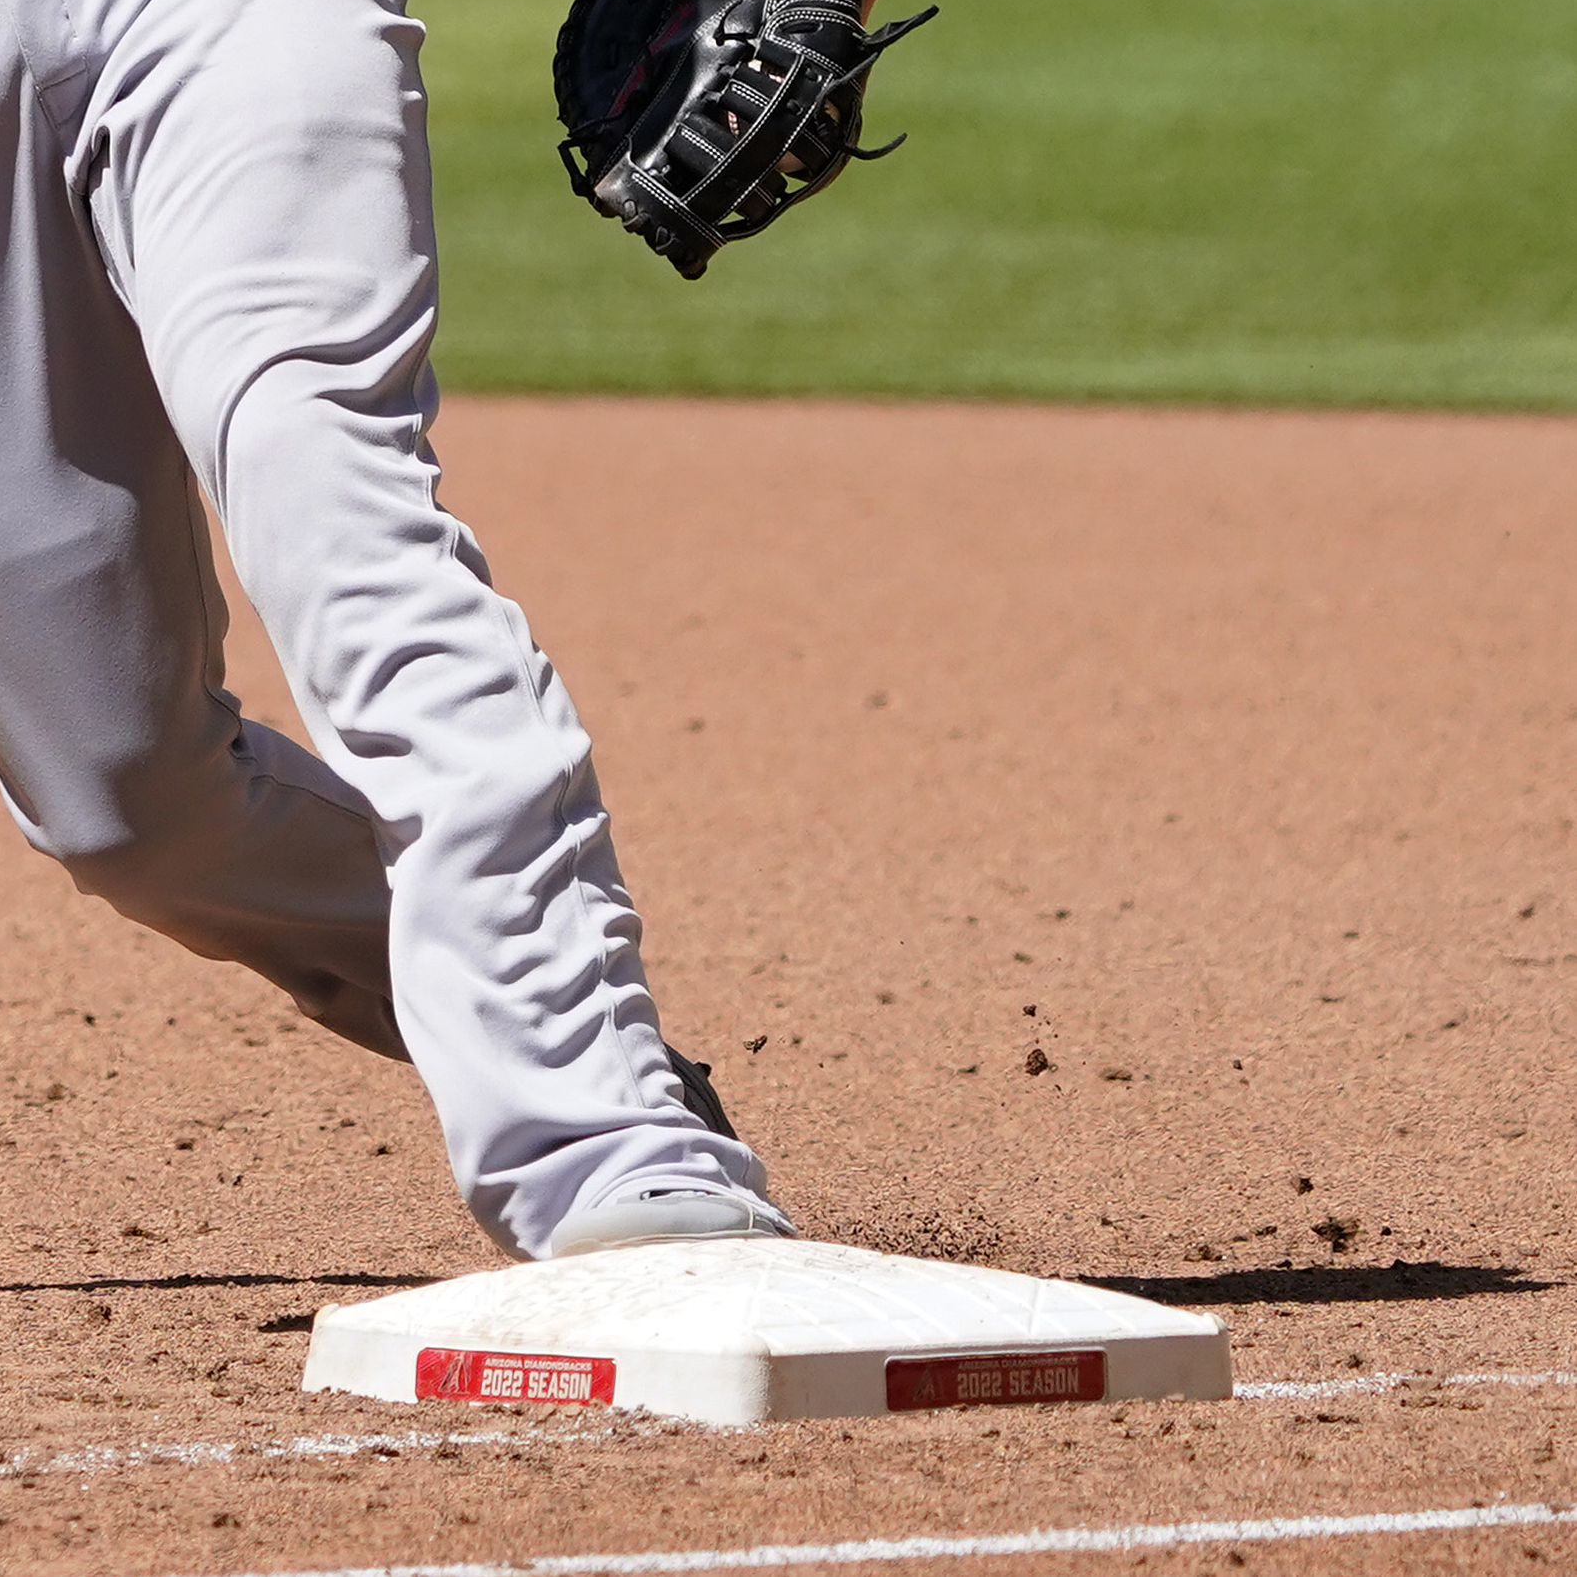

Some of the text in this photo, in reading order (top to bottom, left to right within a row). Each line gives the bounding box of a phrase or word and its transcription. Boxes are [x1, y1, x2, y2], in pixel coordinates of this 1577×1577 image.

[484, 1358, 593, 1372] ARIZONA DIAMONDBACKS
[480, 1368, 593, 1400] 2022 SEASON
[957, 1367, 1079, 1399] 2022 SEASON
